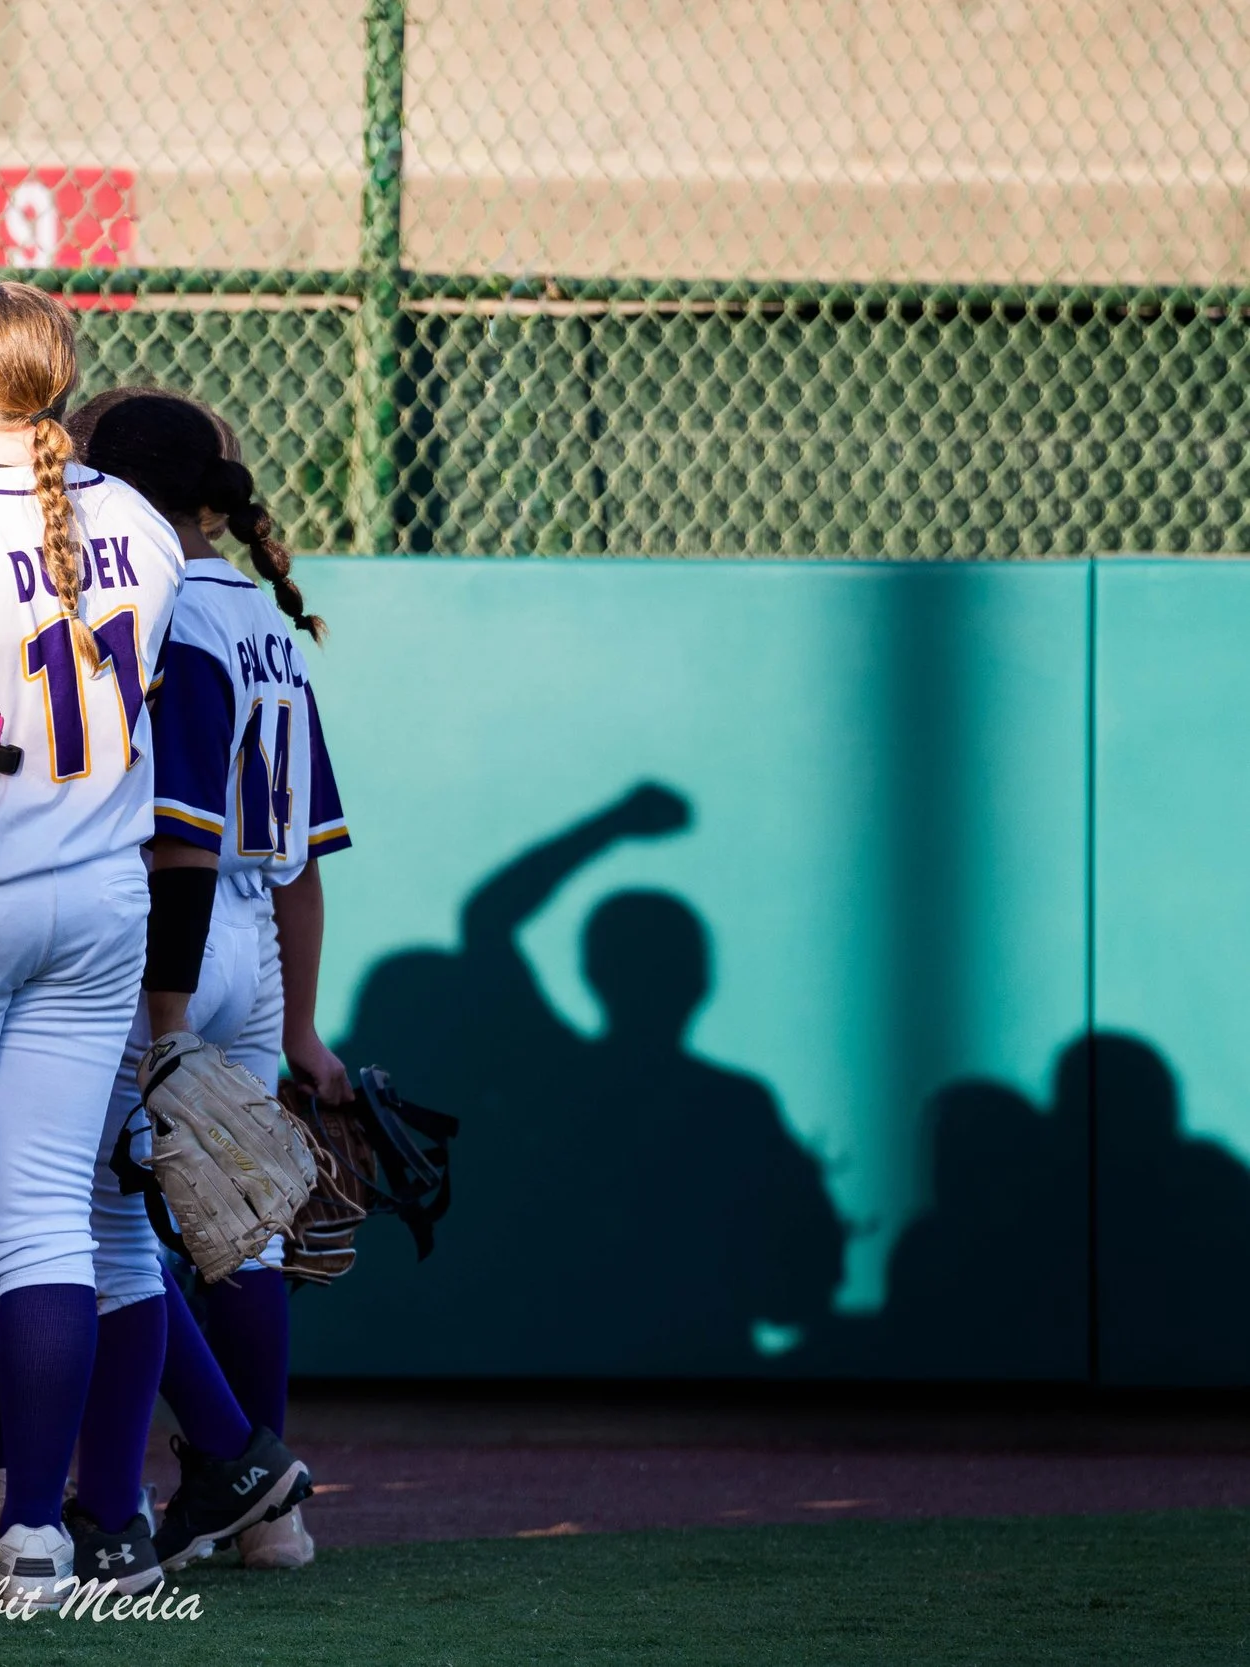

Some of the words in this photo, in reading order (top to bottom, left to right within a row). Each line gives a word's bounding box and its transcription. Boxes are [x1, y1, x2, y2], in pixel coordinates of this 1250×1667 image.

[5, 181, 58, 268] 9
[21, 604, 146, 784] 11
[236, 697, 293, 861] 14
